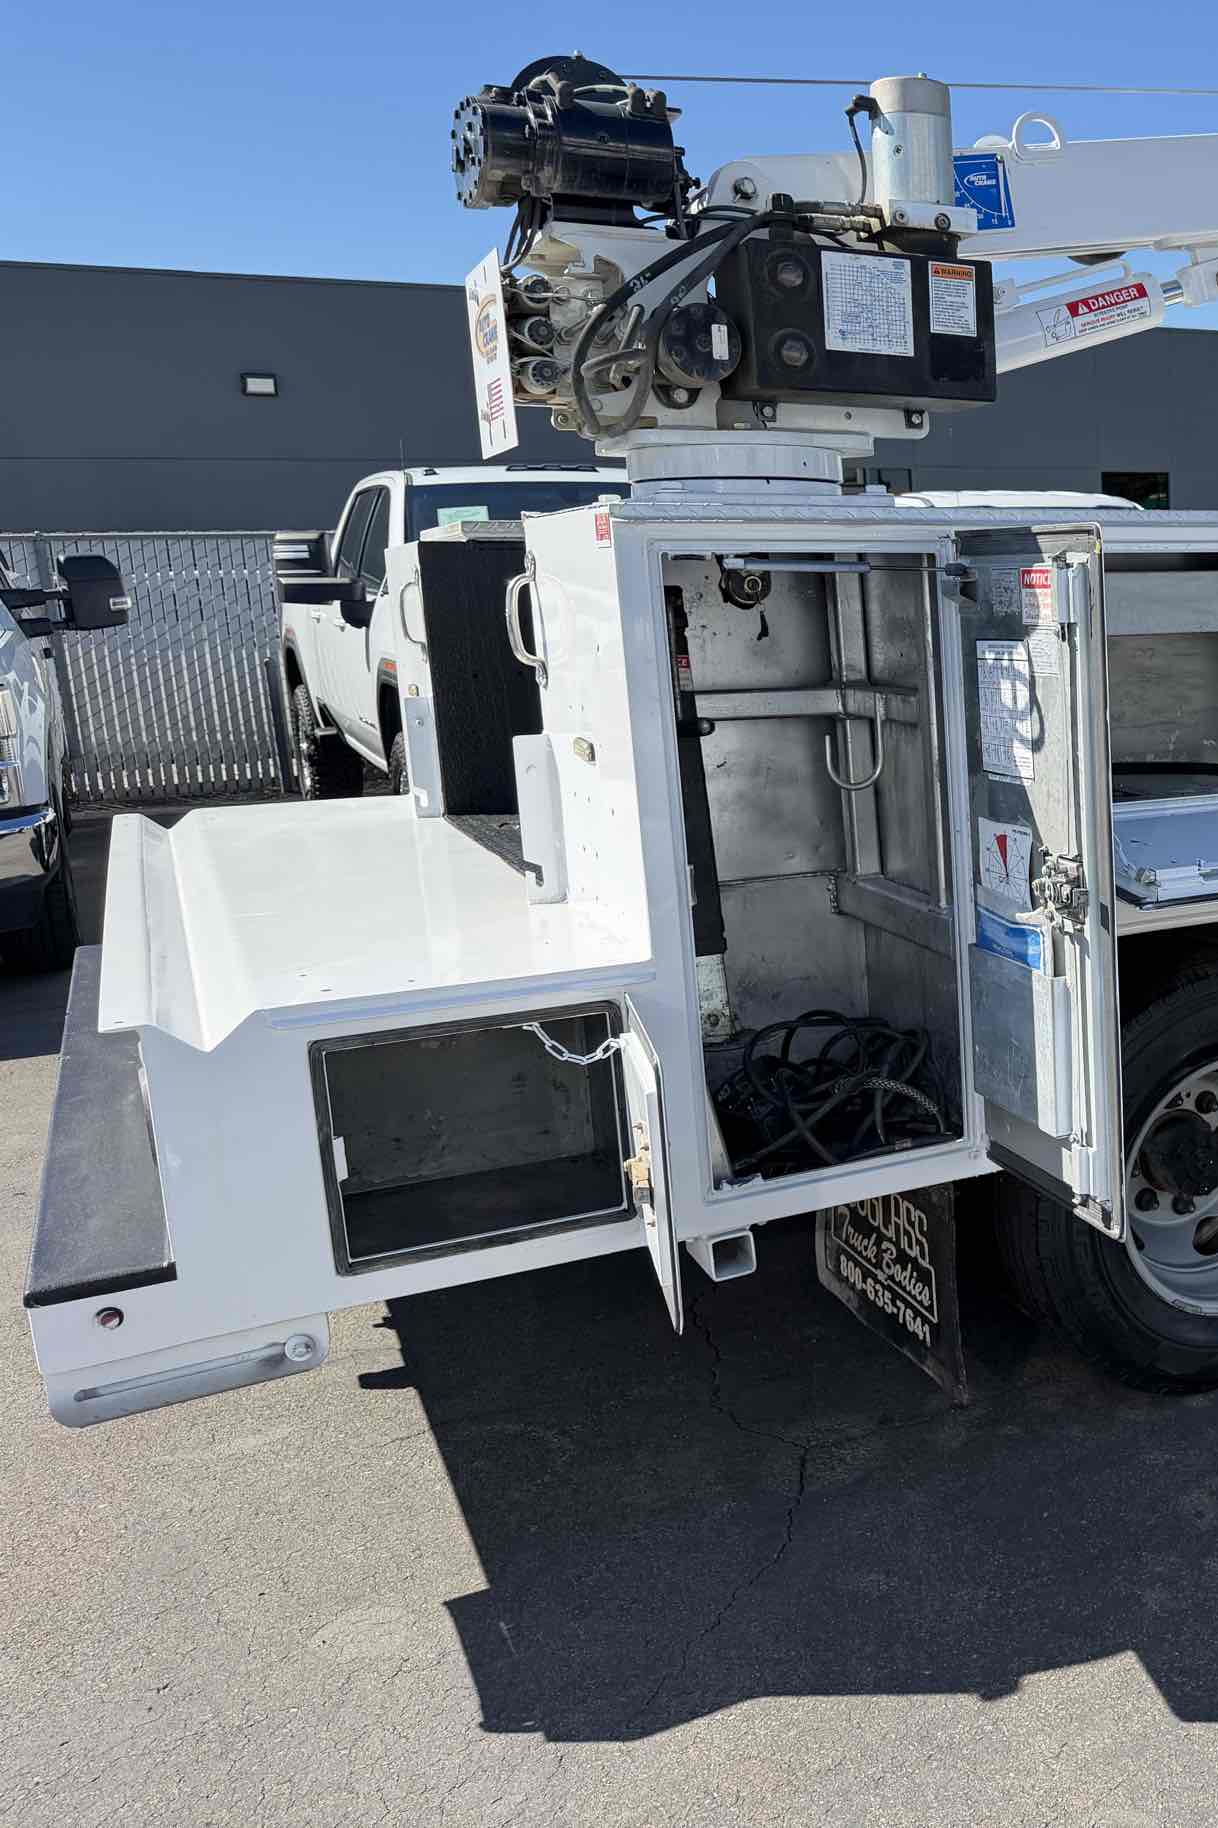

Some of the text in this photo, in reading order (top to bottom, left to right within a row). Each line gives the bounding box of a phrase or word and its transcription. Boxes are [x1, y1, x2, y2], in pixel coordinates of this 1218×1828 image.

[939, 267, 973, 278] WARNING
[1088, 286, 1140, 310] DANGER
[837, 1206, 932, 1307] Truck Bodies
[850, 1191, 930, 1268] GLASS
[839, 1253, 931, 1348] 800-635-7641
